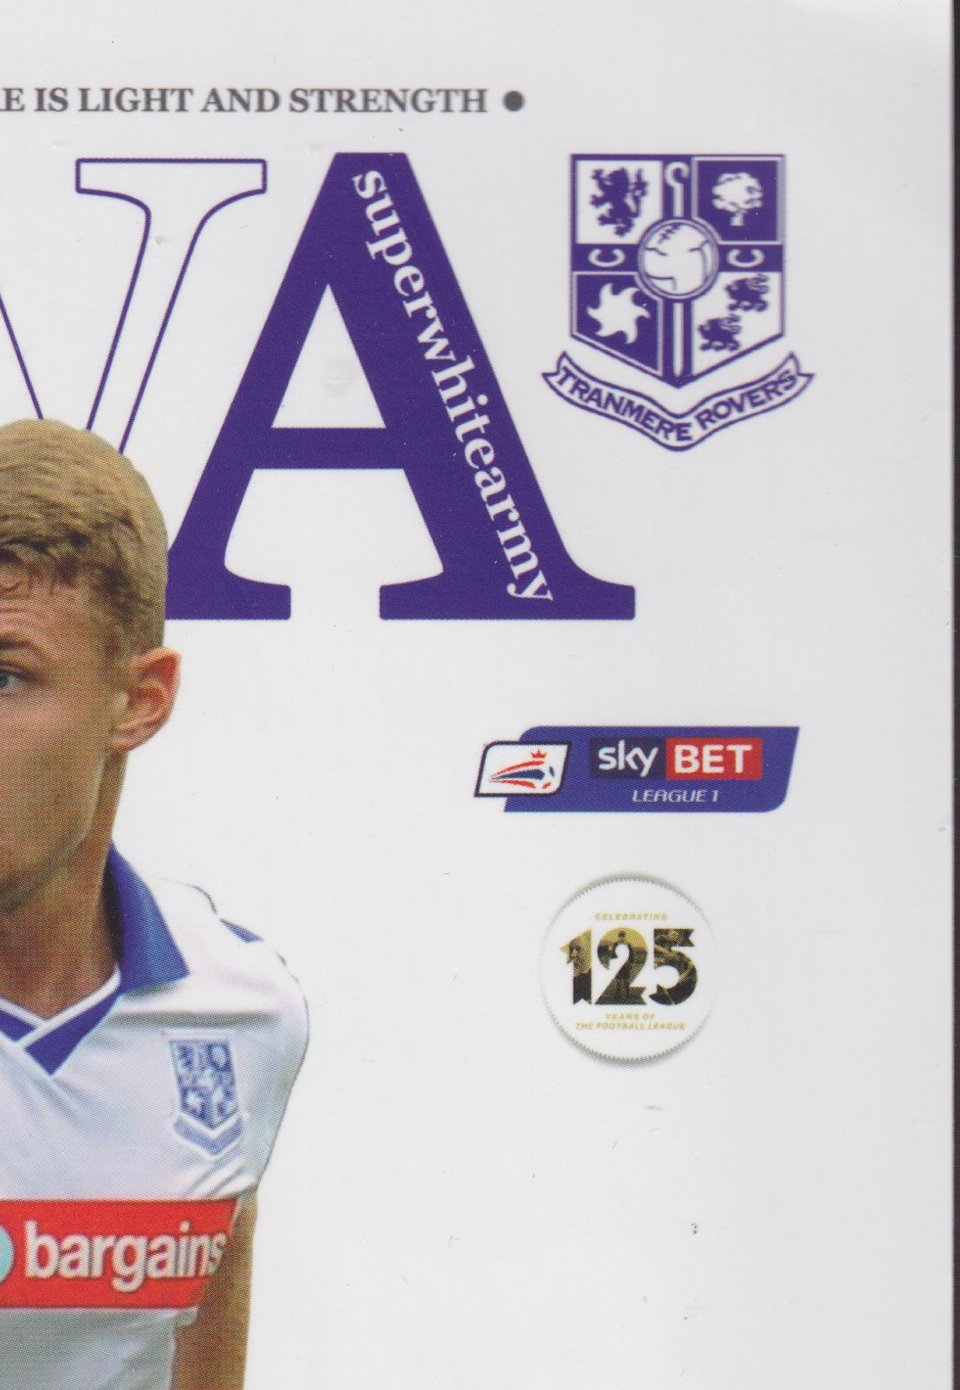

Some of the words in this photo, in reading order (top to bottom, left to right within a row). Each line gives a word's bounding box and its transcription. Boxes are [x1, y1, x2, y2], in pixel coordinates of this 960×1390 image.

[35, 87, 68, 112] IS
[78, 87, 193, 112] LIGHT
[201, 88, 280, 112] AND
[289, 88, 487, 113] STRENGTH
[352, 169, 554, 602] superwhitearmy
[556, 366, 692, 441] TRANMERE
[694, 369, 797, 430] ROVERS
[598, 739, 659, 777] sky
[674, 744, 753, 774] BET
[632, 789, 708, 803] LEAGUE
[712, 789, 720, 802] 1
[594, 912, 669, 920] CELEBRATING
[560, 926, 698, 1006] 125
[596, 1022, 645, 1030] FOOTBALL
[647, 1022, 686, 1030] LEAGUE
[24, 1220, 227, 1292] bargains
